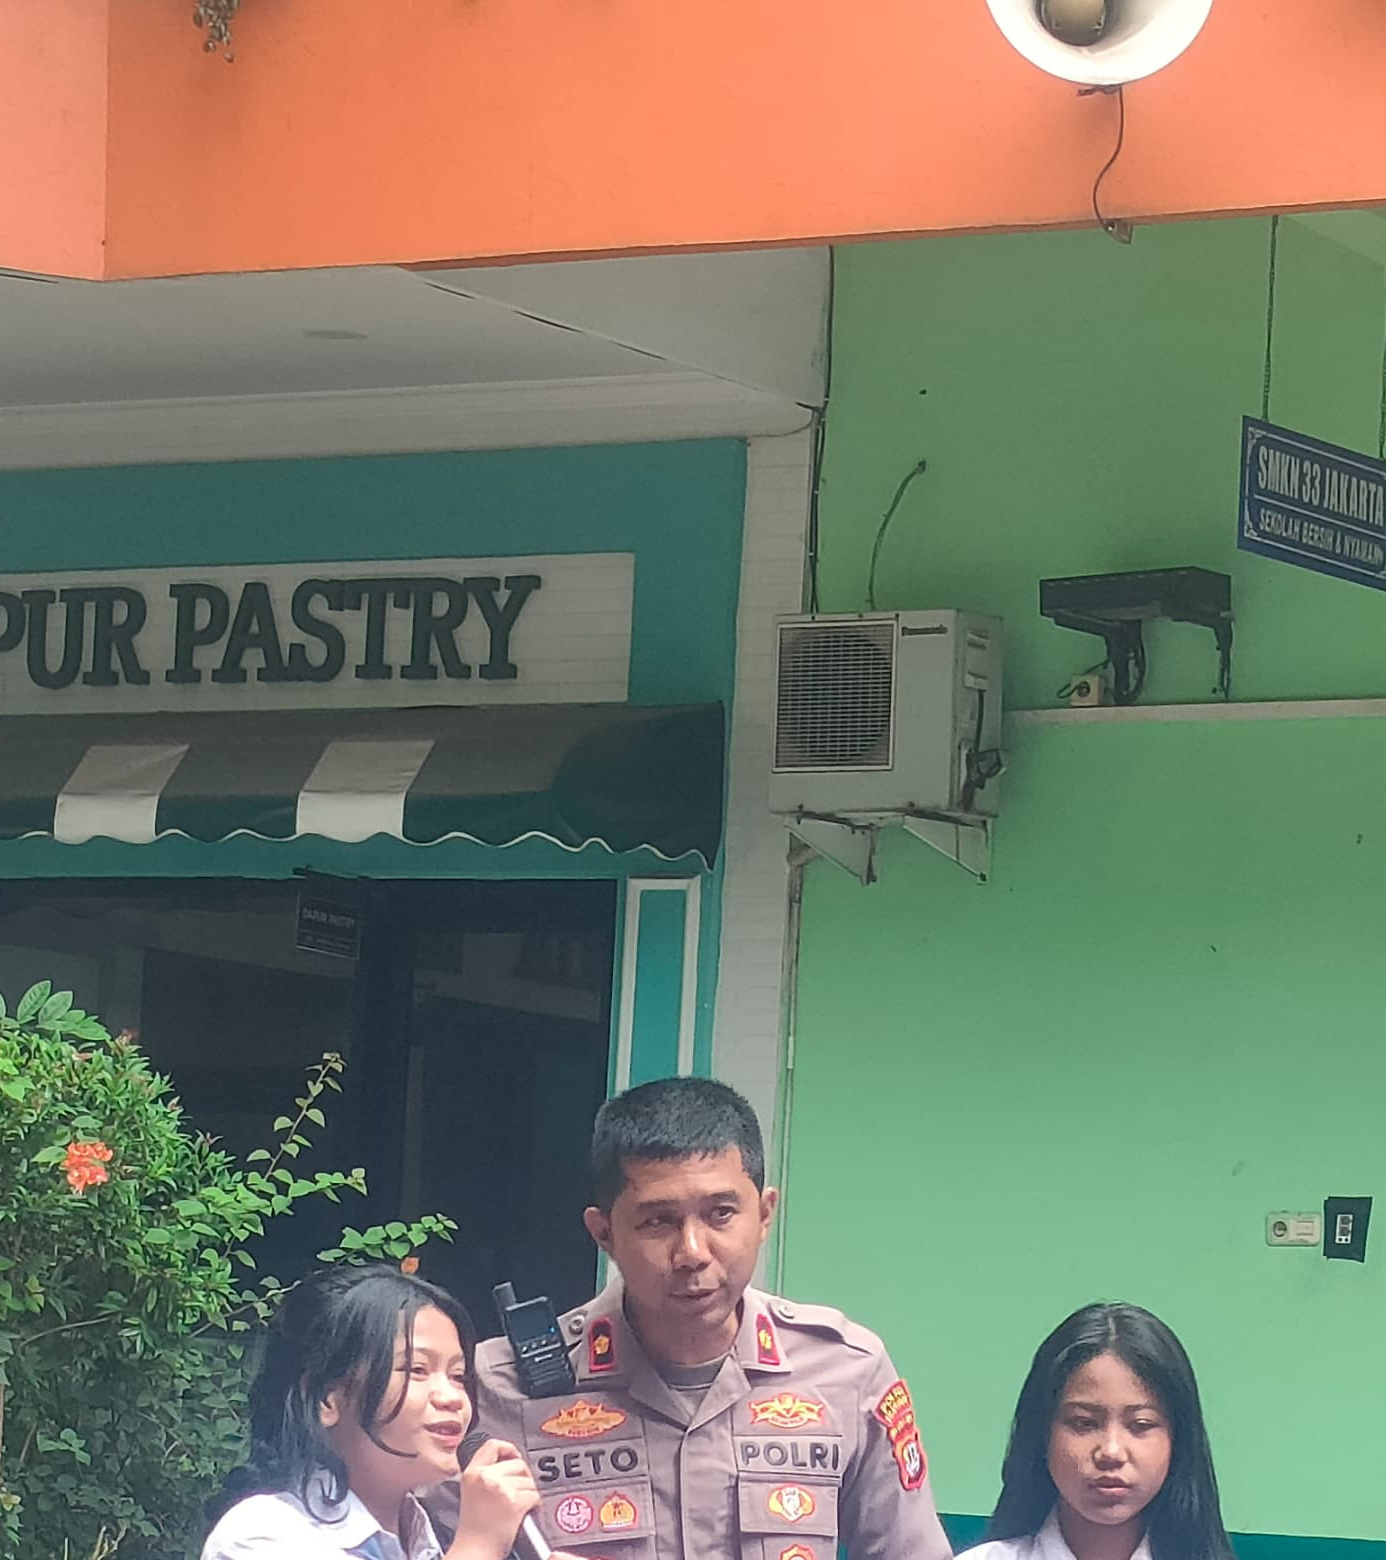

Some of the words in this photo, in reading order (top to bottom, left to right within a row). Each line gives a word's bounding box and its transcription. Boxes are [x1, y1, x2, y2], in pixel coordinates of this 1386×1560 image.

[1258, 446, 1300, 498] SMKN
[1302, 460, 1321, 506] 33
[1323, 468, 1384, 527] JAKARTA
[1260, 508, 1300, 540] SEKOLAH
[1302, 521, 1333, 550] BERSIH
[165, 575, 542, 684] PASTRY
[538, 1447, 639, 1482] SETO
[740, 1441, 839, 1471] POLRI
